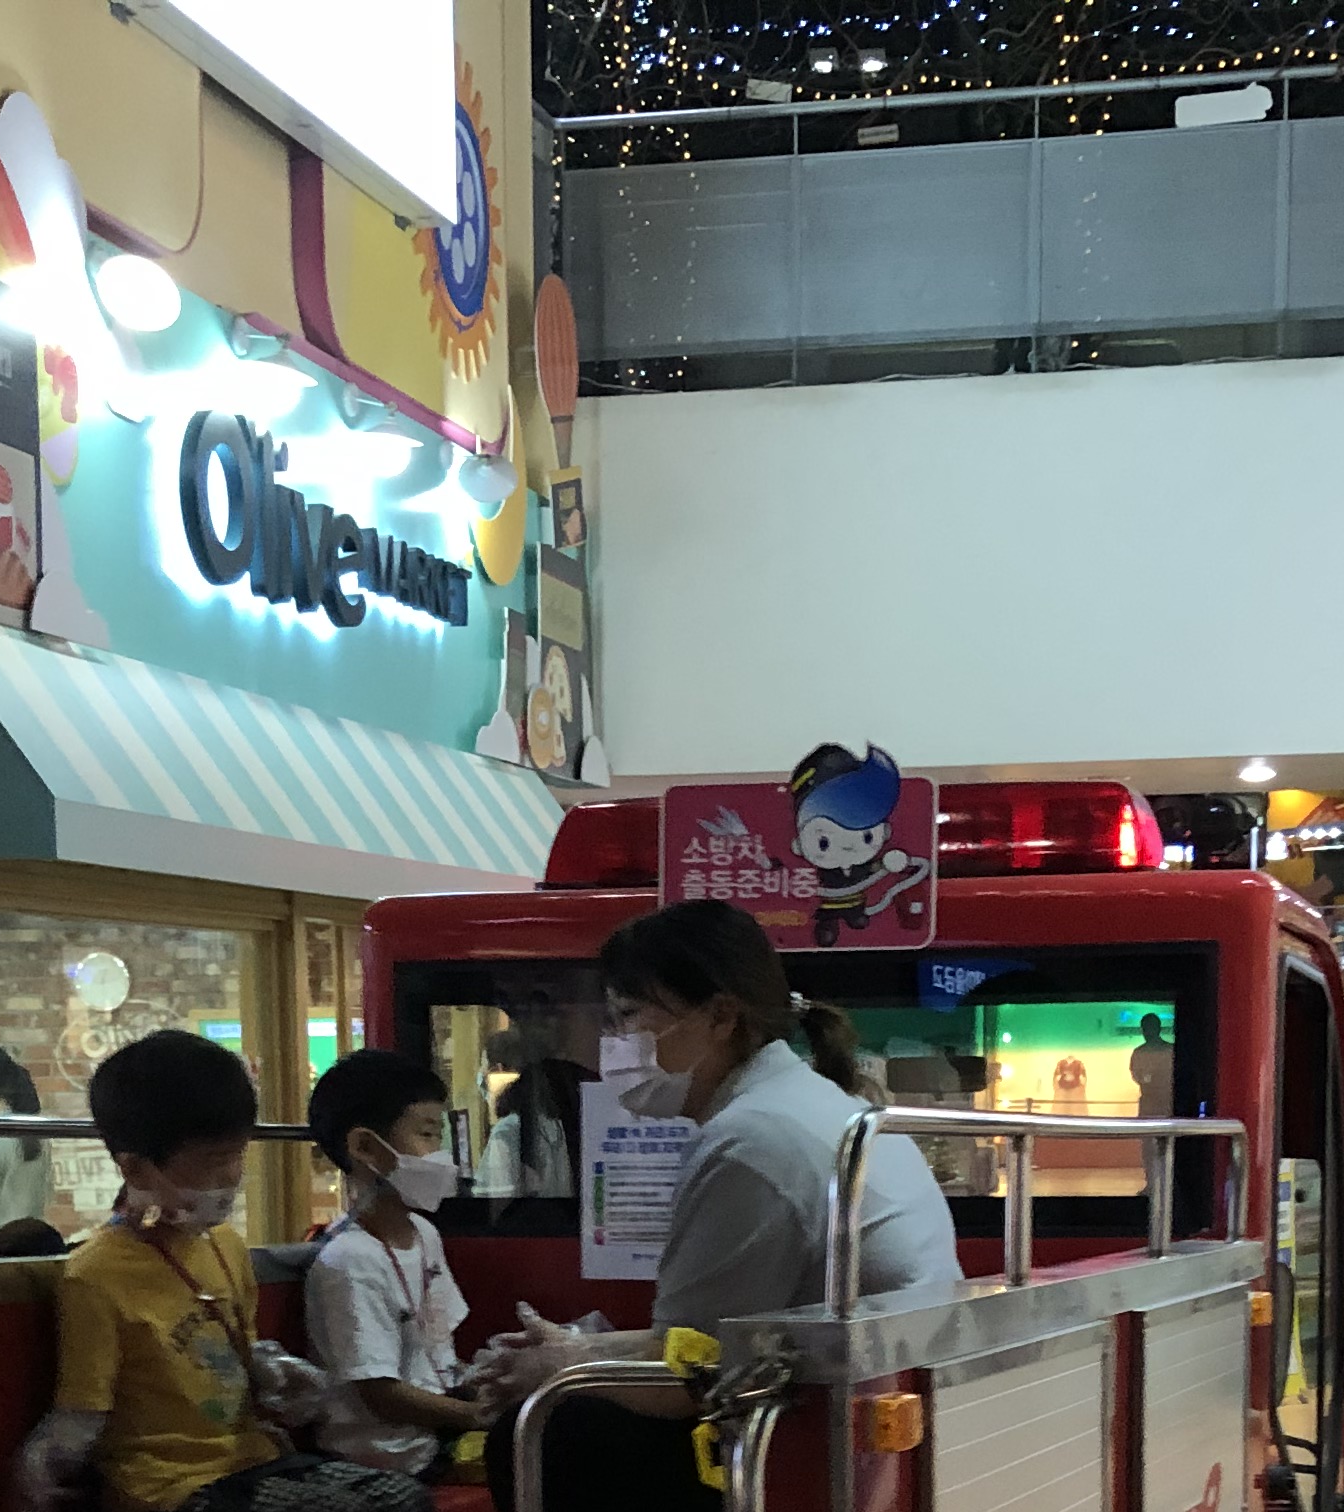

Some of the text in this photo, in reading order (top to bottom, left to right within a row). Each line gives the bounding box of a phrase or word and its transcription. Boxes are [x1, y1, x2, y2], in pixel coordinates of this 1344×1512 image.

[179, 410, 367, 628] Olive
[680, 835, 768, 867] 소방차
[680, 868, 818, 900] 출동준비중
